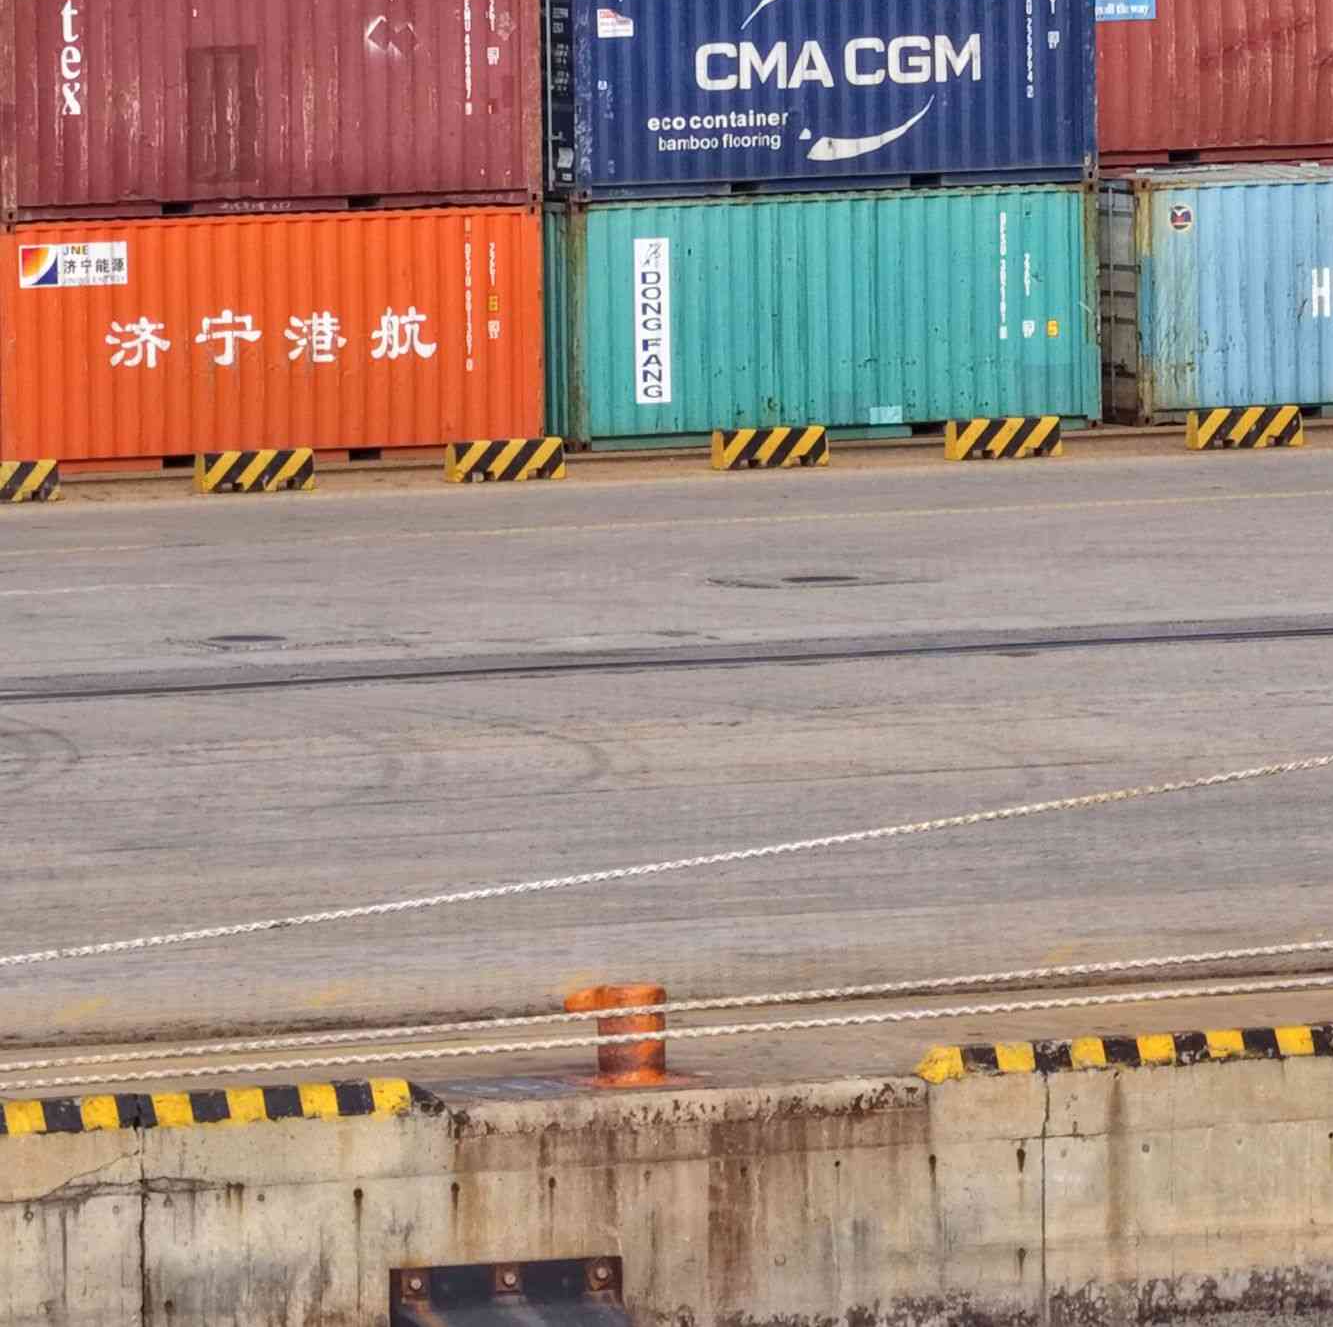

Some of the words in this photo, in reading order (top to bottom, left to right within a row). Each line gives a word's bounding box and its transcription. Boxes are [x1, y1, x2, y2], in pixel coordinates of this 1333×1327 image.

[695, 39, 834, 91] CMA
[844, 33, 982, 84] CGM
[647, 116, 686, 132] eco
[690, 110, 789, 130] container
[658, 134, 718, 151] bamboo
[722, 130, 782, 150] flooring
[63, 245, 89, 256] JNE
[63, 257, 125, 275] 济宁能源
[640, 271, 663, 331] DONG
[104, 306, 438, 369] 济宁港航
[642, 338, 664, 399] FANG
